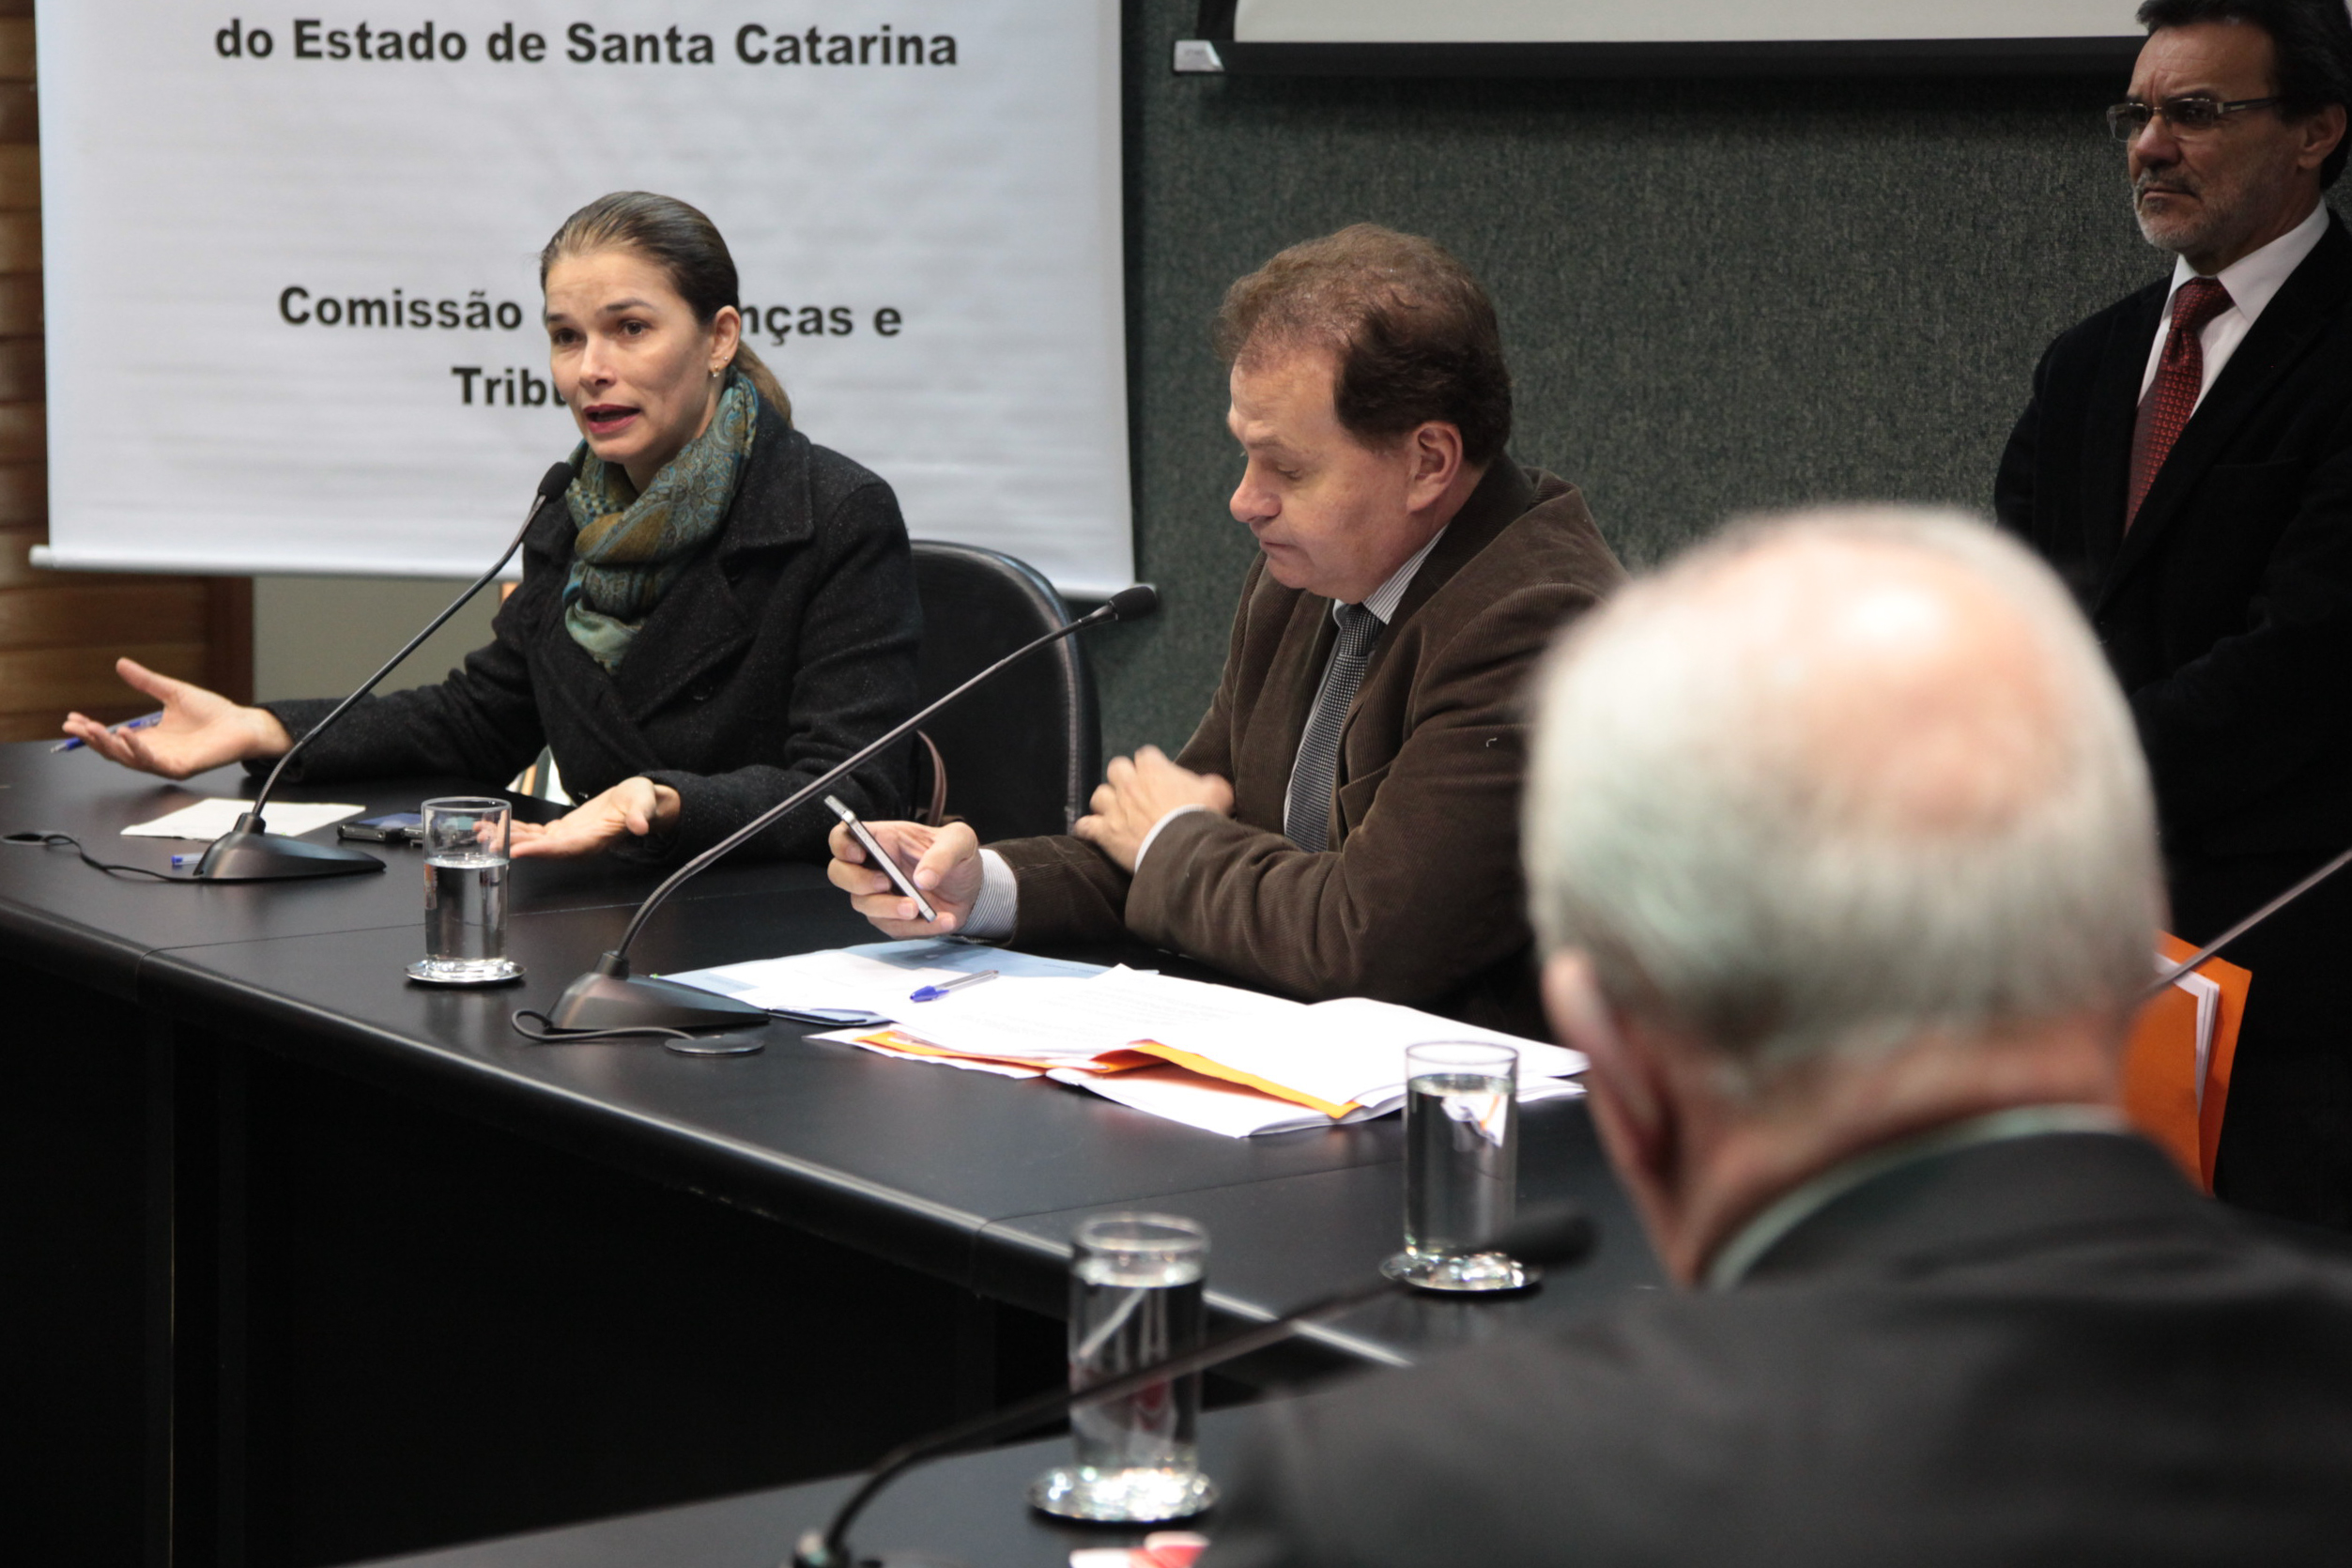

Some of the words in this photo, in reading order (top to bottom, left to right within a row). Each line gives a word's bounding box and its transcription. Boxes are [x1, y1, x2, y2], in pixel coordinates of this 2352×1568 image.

[215, 17, 274, 60] do
[293, 18, 468, 63] Estado
[486, 21, 547, 65] de
[566, 22, 715, 66] Santa
[735, 23, 959, 68] Catarina
[279, 285, 523, 332] Comissão
[873, 306, 902, 338] e
